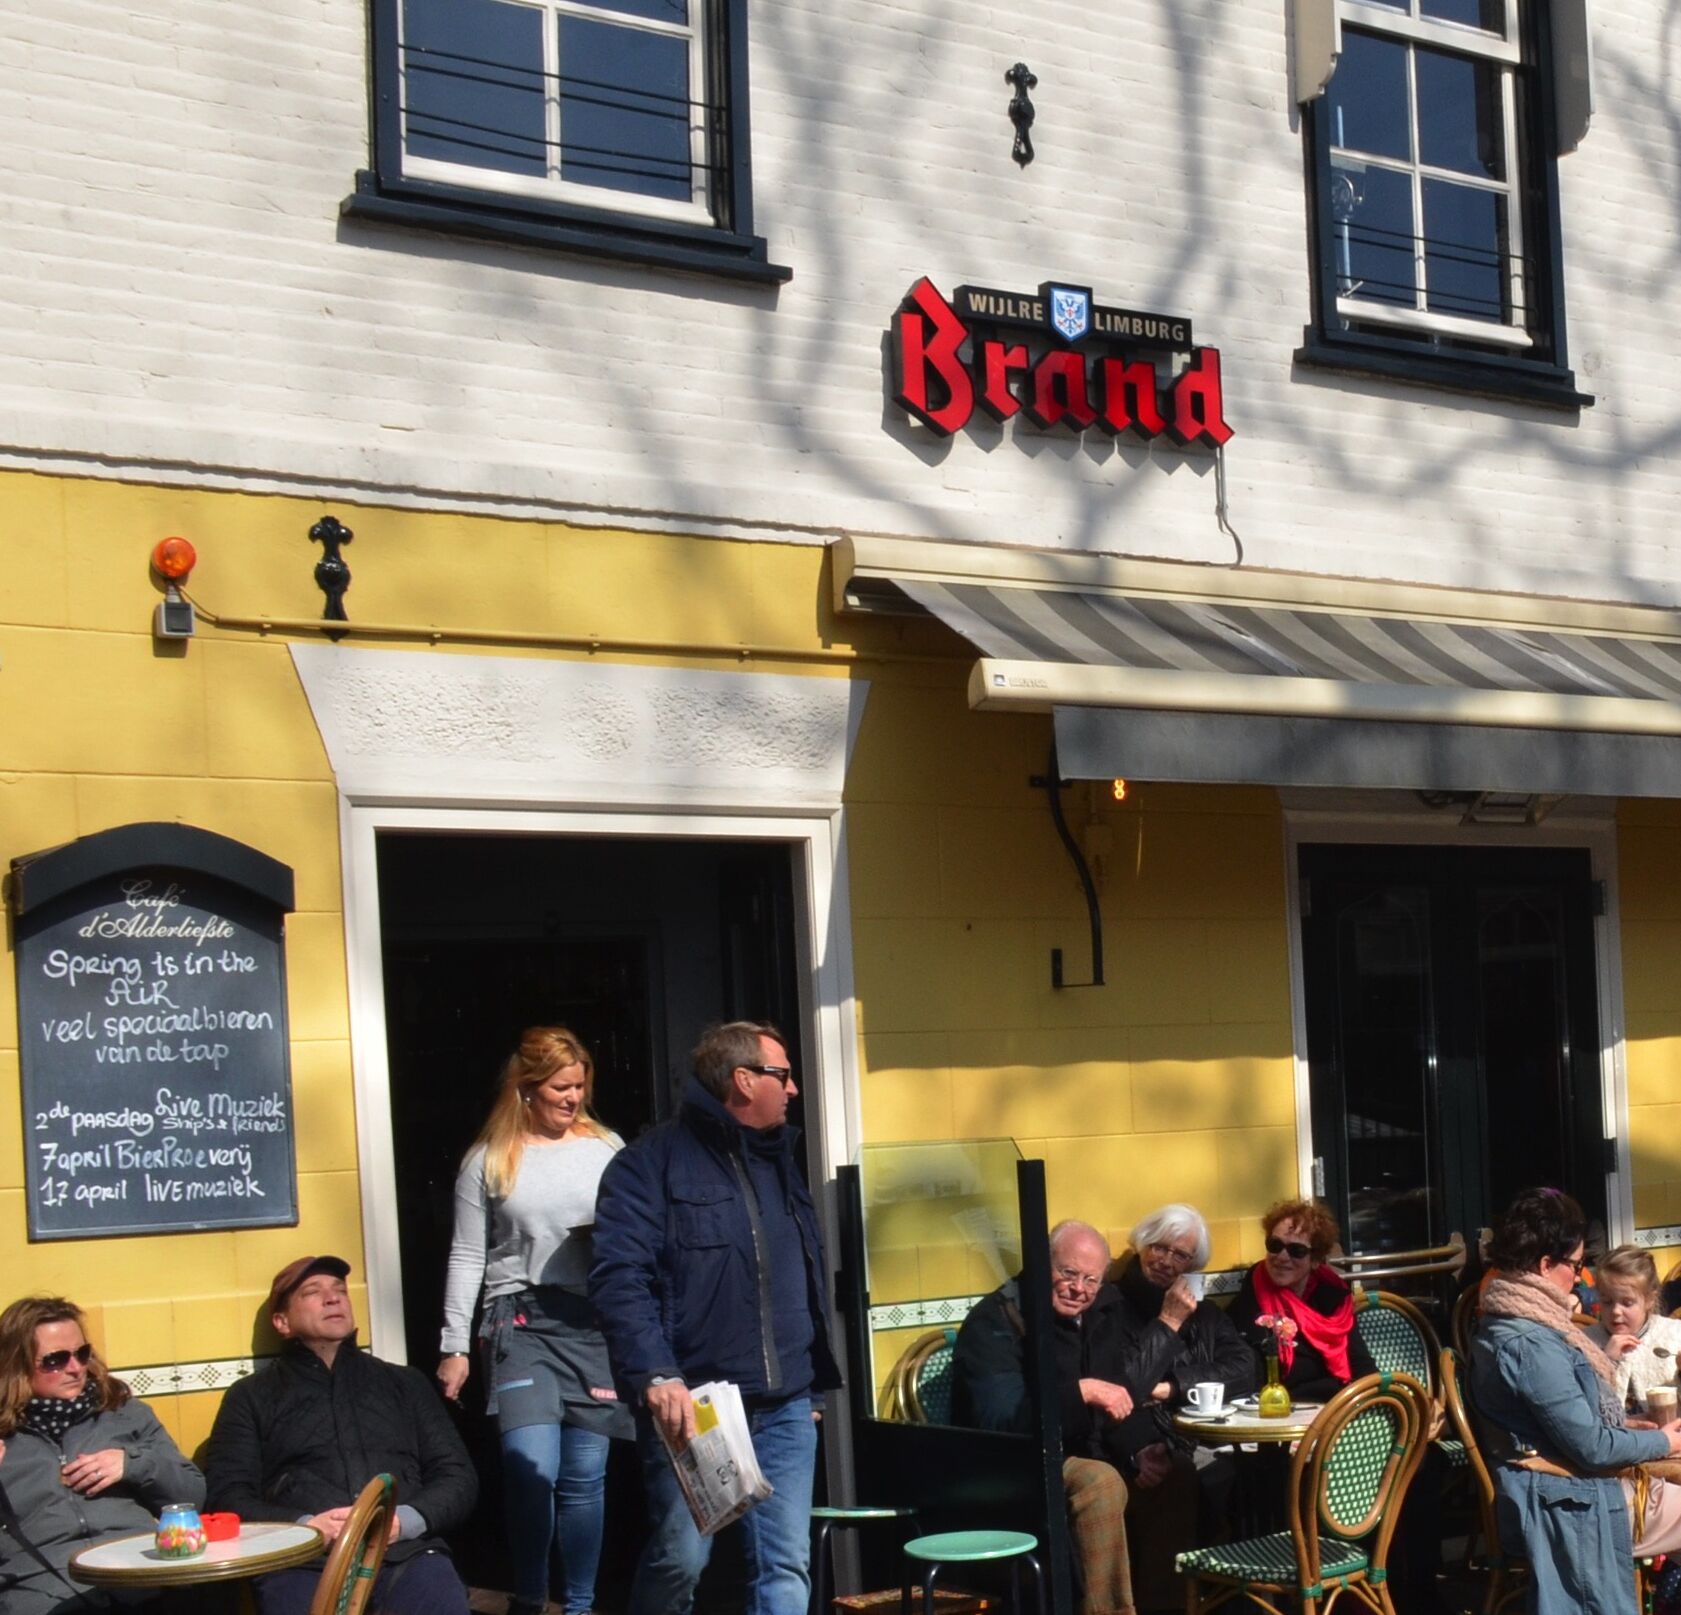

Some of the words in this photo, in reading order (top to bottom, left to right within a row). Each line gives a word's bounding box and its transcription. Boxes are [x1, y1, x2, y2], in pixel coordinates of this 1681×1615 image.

[968, 293, 1043, 321] WIJLRE
[1095, 312, 1185, 342] LIMBURG
[900, 275, 1235, 447] Brand
[120, 879, 186, 919] Café
[152, 951, 178, 976] is
[184, 952, 214, 974] in
[216, 950, 258, 974] the
[42, 1011, 97, 1043] veel
[96, 1045, 142, 1064] van
[147, 1038, 180, 1062] de
[181, 1039, 230, 1071] tap
[154, 1087, 203, 1117] Live
[208, 1092, 287, 1118] Muziek
[39, 1142, 58, 1171] 7
